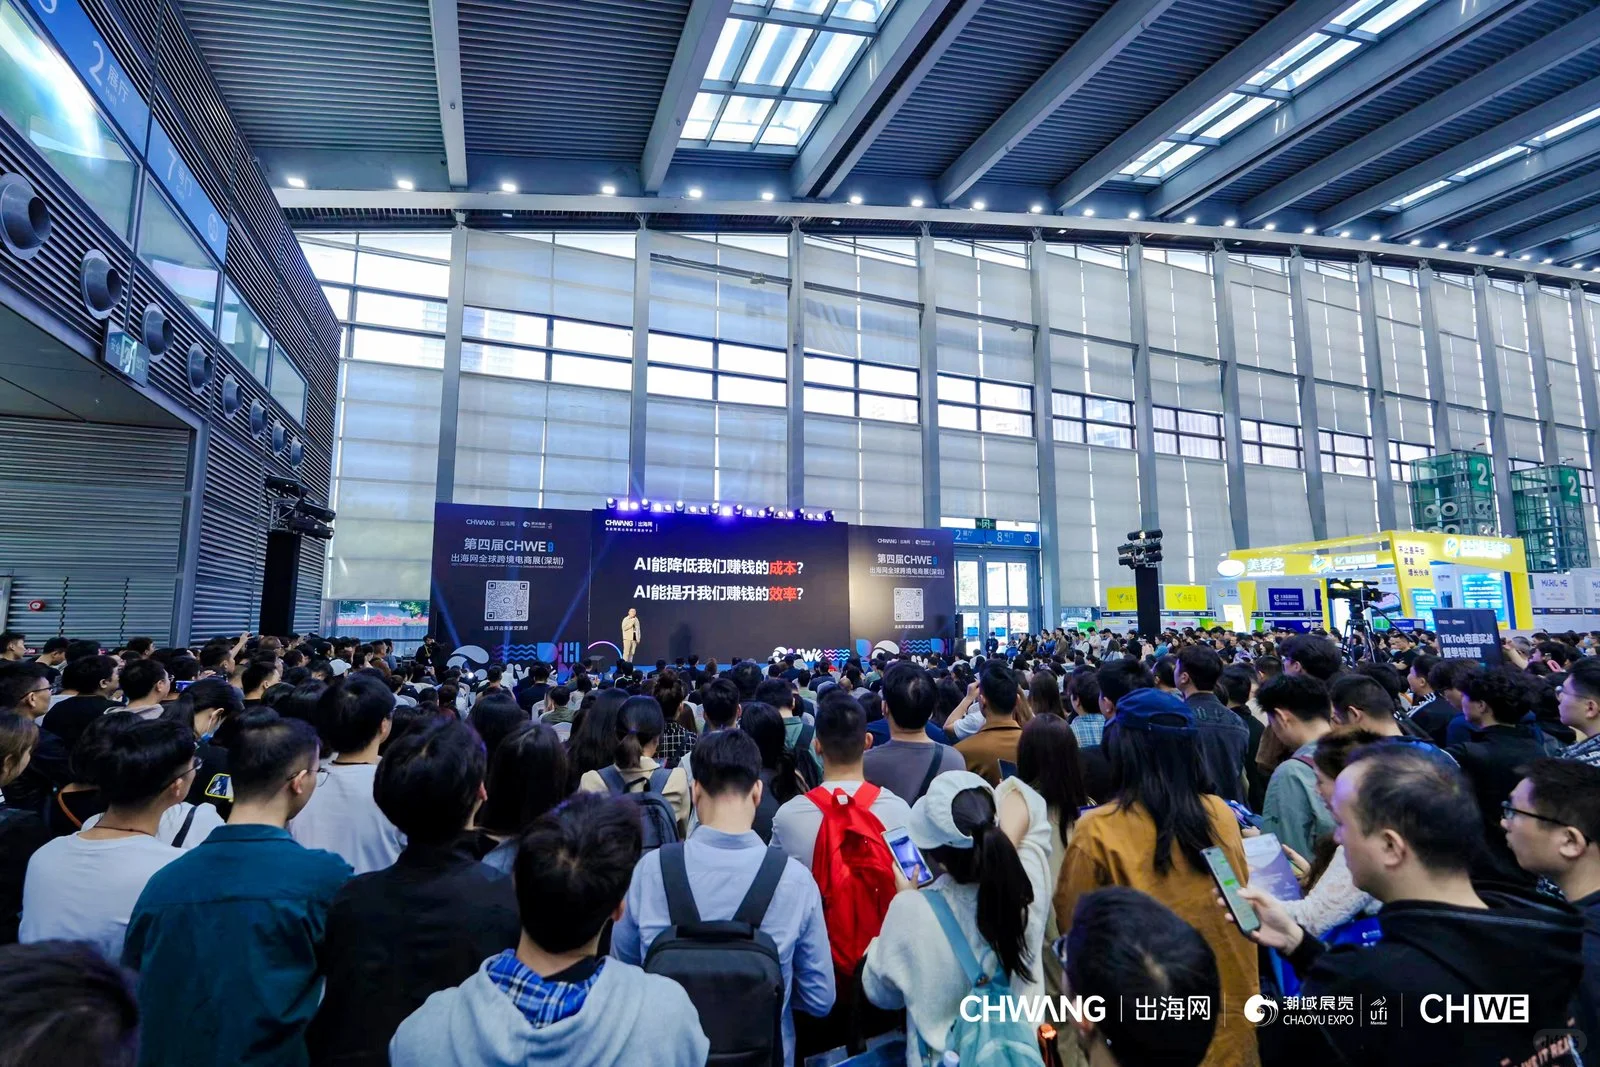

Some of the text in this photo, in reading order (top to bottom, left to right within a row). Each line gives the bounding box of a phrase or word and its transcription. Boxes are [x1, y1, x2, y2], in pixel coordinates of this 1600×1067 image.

[89, 41, 130, 103] 2 展厅
[167, 148, 193, 198] 7 号门
[1477, 463, 1488, 486] 2
[1567, 476, 1578, 497] 2
[605, 519, 633, 527] CHWANG
[955, 529, 961, 540] 2
[997, 531, 1003, 543] 8
[464, 538, 546, 552] 第四届CHWE
[451, 553, 564, 565] 出海网全球跨境电商展(深圳)
[634, 557, 804, 576] AI能降低我们赚钱的成本?
[877, 553, 932, 565] 第四届CHWE
[633, 584, 804, 602] AI能提升我们赚钱的效率?
